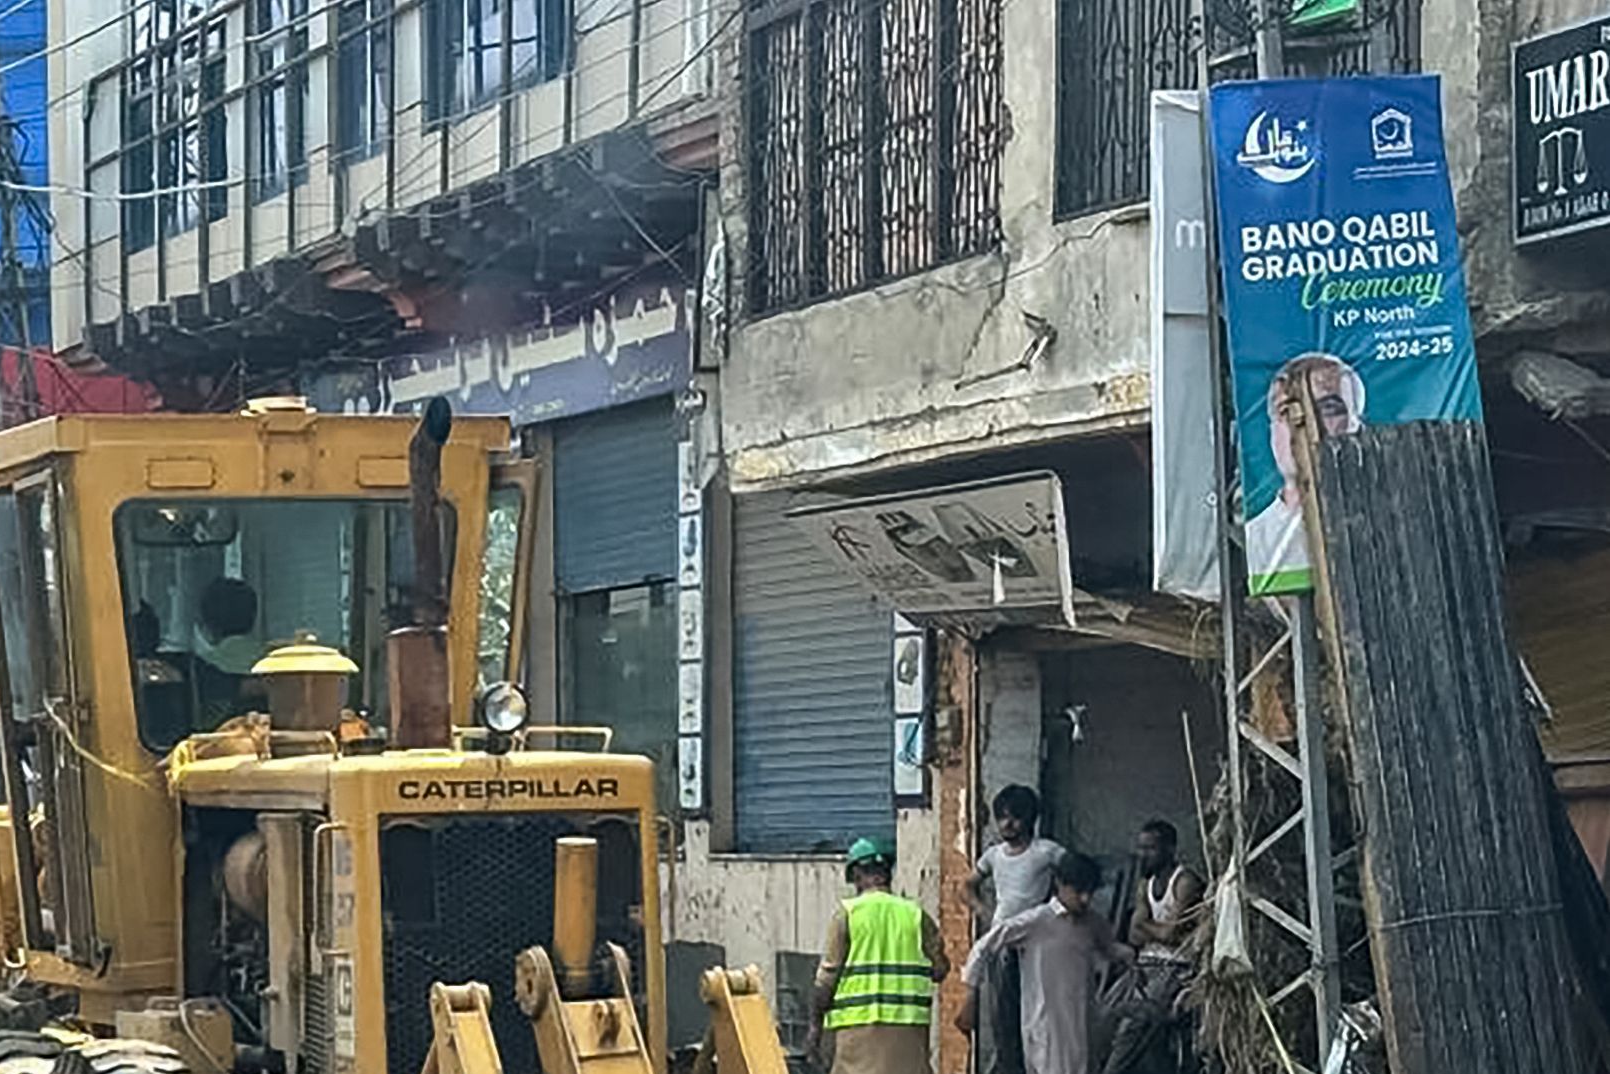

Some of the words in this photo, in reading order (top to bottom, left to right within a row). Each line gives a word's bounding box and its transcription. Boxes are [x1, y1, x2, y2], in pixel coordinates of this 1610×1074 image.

[1526, 50, 1610, 125] UMAR
[1242, 219, 1335, 253] BANO
[1342, 211, 1435, 246] QABIL
[1242, 241, 1439, 281] GRADUATION
[1301, 268, 1444, 310] Ceremony
[1333, 310, 1360, 327] KP
[1364, 304, 1415, 324] North
[1375, 336, 1454, 361] 2024-25
[398, 779, 619, 799] CATERPILLAR
